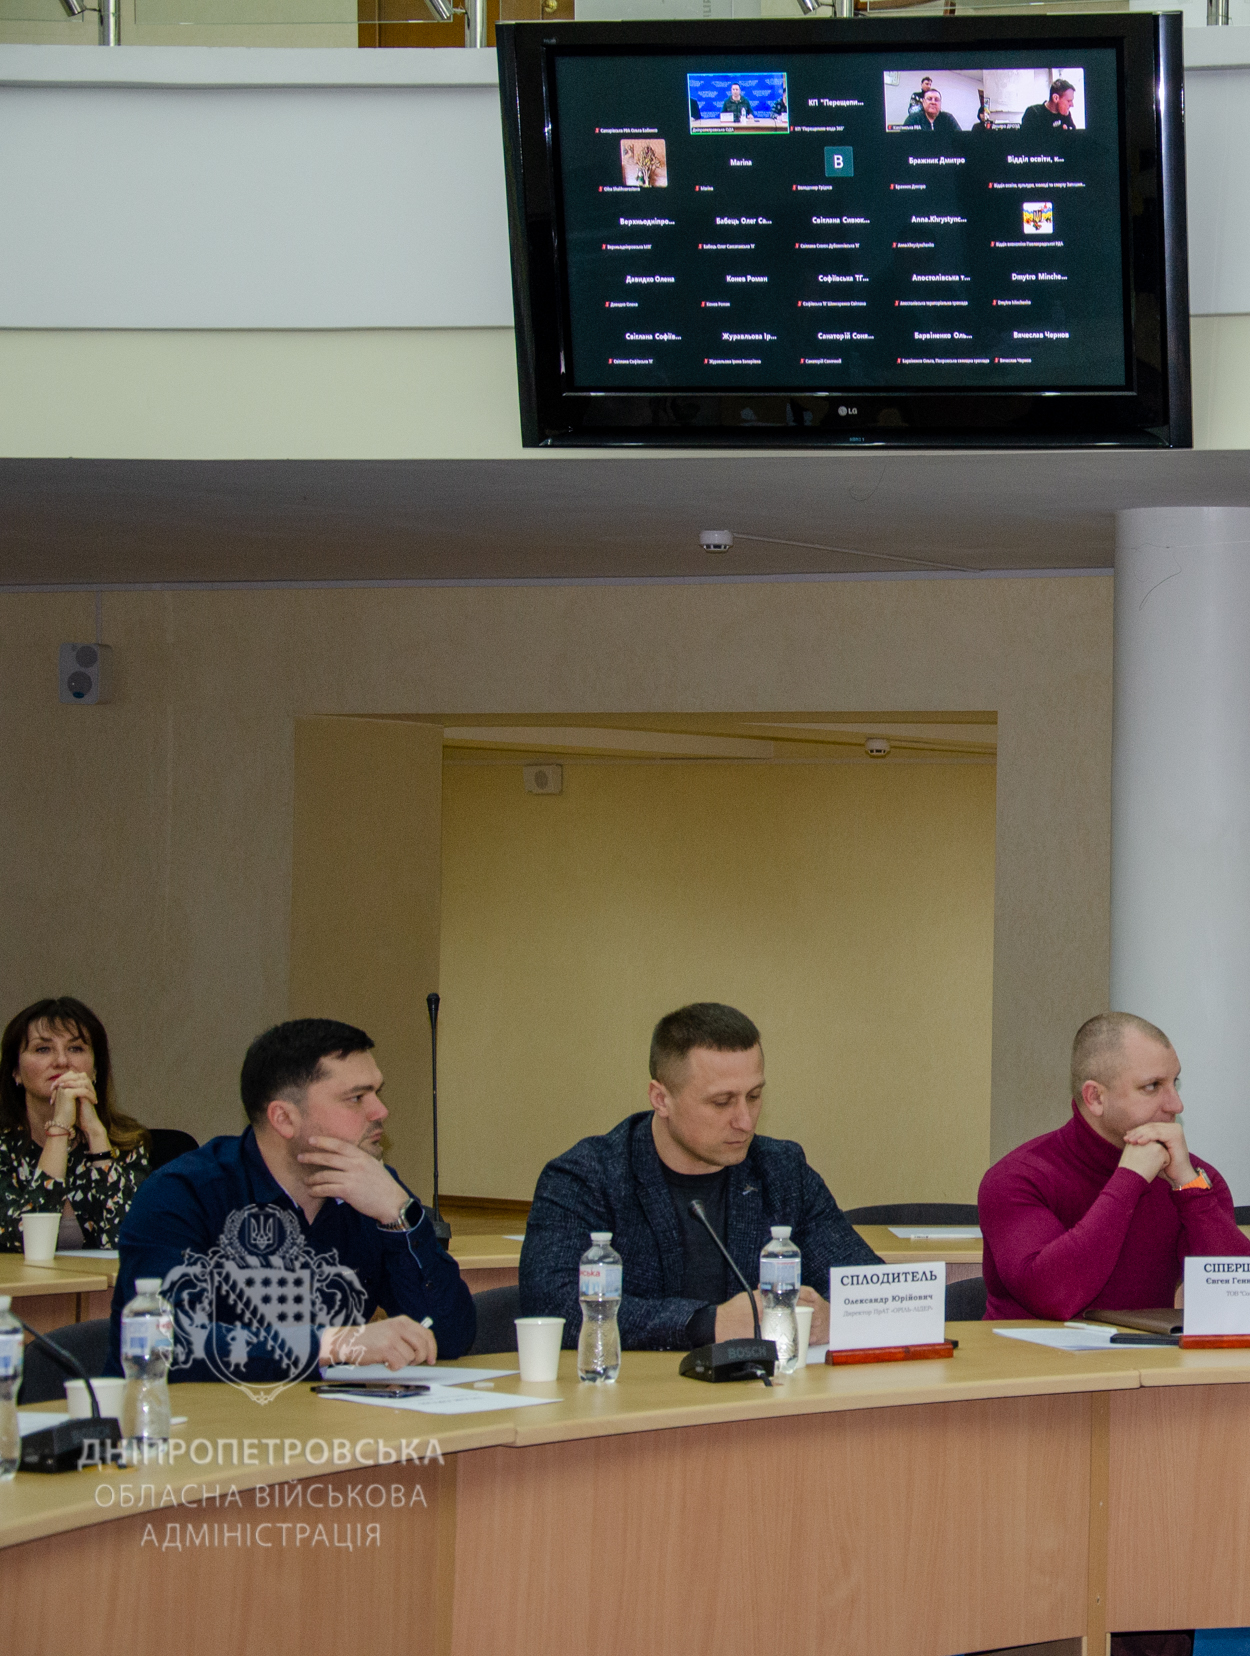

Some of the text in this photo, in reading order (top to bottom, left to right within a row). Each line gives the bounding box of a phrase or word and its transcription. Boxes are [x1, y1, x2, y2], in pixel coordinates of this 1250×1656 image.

[908, 157, 966, 165] Бражник Дмитро
[1007, 155, 1029, 164] Відділ
[1030, 155, 1053, 163] освіти,
[716, 217, 739, 225] Бабець
[818, 275, 854, 283] Софіївська
[721, 333, 763, 341] Журавльова
[817, 332, 851, 340] Санаторій
[914, 332, 952, 340] Барвіненко
[1044, 331, 1070, 339] Чернов
[848, 407, 858, 415] LG
[840, 1270, 938, 1286] СПЛОДИТЕЛЬ
[843, 1294, 933, 1306] Олександр Юрійович
[843, 1309, 872, 1318] Директор
[728, 1346, 767, 1359] BOSCH
